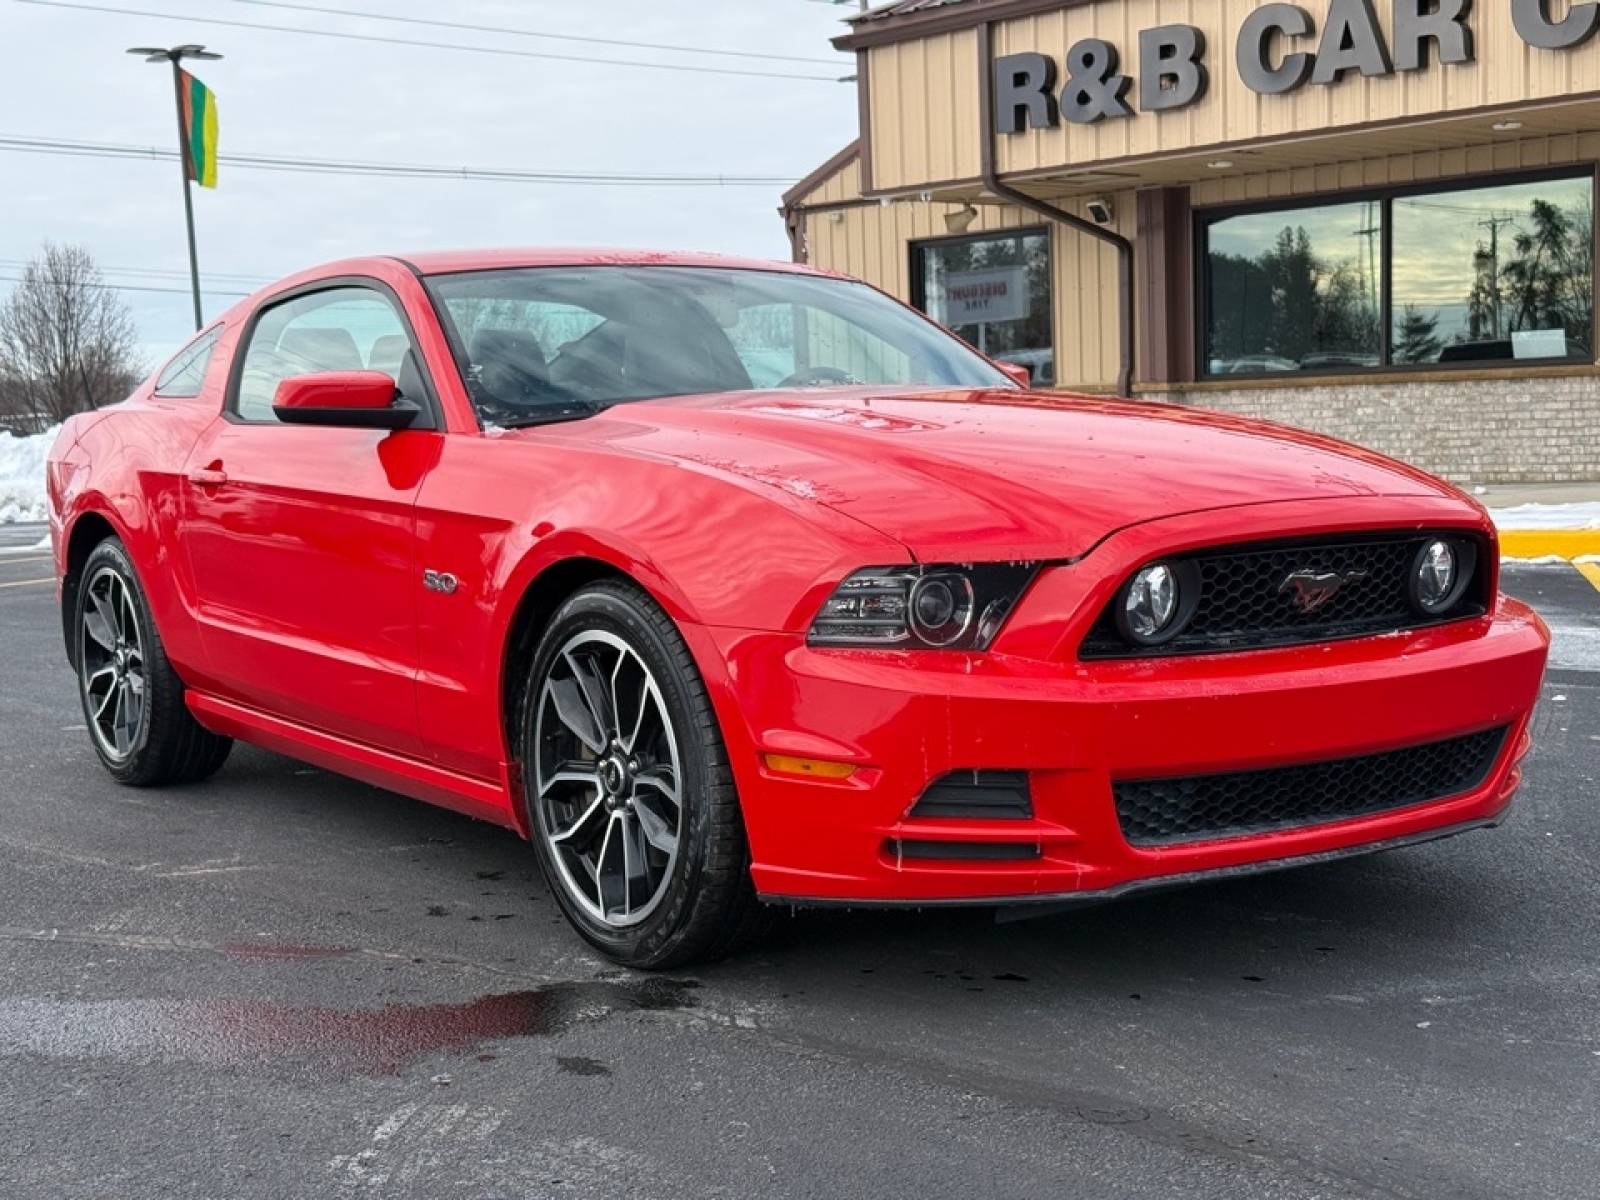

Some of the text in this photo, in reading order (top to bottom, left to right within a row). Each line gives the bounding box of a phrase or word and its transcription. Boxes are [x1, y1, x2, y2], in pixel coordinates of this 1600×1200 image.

[993, 24, 1209, 134] R&B
[1236, 0, 1475, 95] CAR
[424, 568, 458, 594] 5.0
